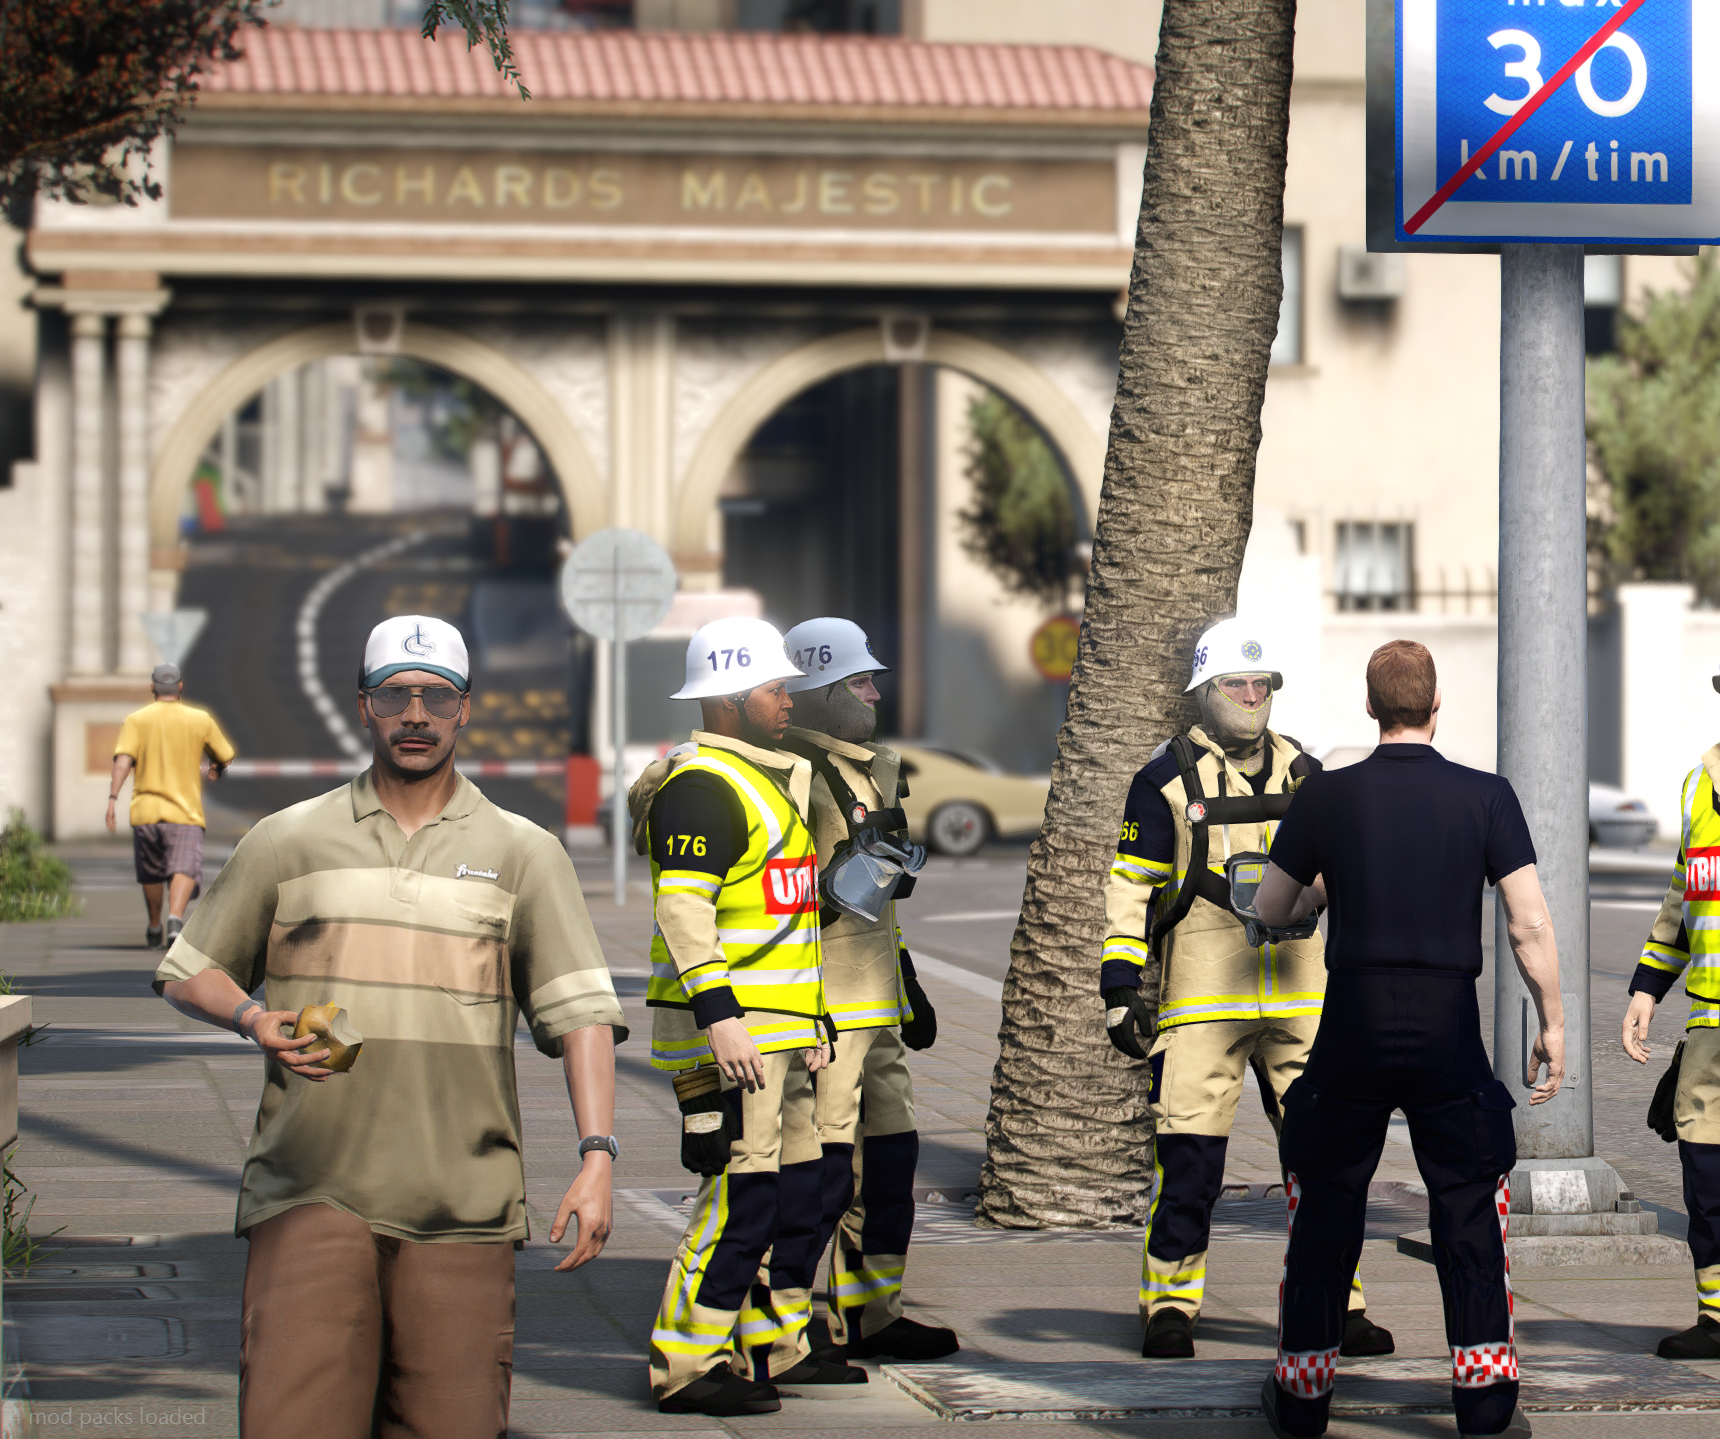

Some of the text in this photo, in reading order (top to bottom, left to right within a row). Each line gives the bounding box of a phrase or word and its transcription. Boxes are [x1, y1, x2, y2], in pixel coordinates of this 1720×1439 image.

[1483, 28, 1648, 117] 30
[267, 162, 1013, 217] RICHARDS MAJESTIC
[707, 646, 751, 671] 176
[1119, 821, 1139, 841] 66
[666, 835, 707, 857] 176
